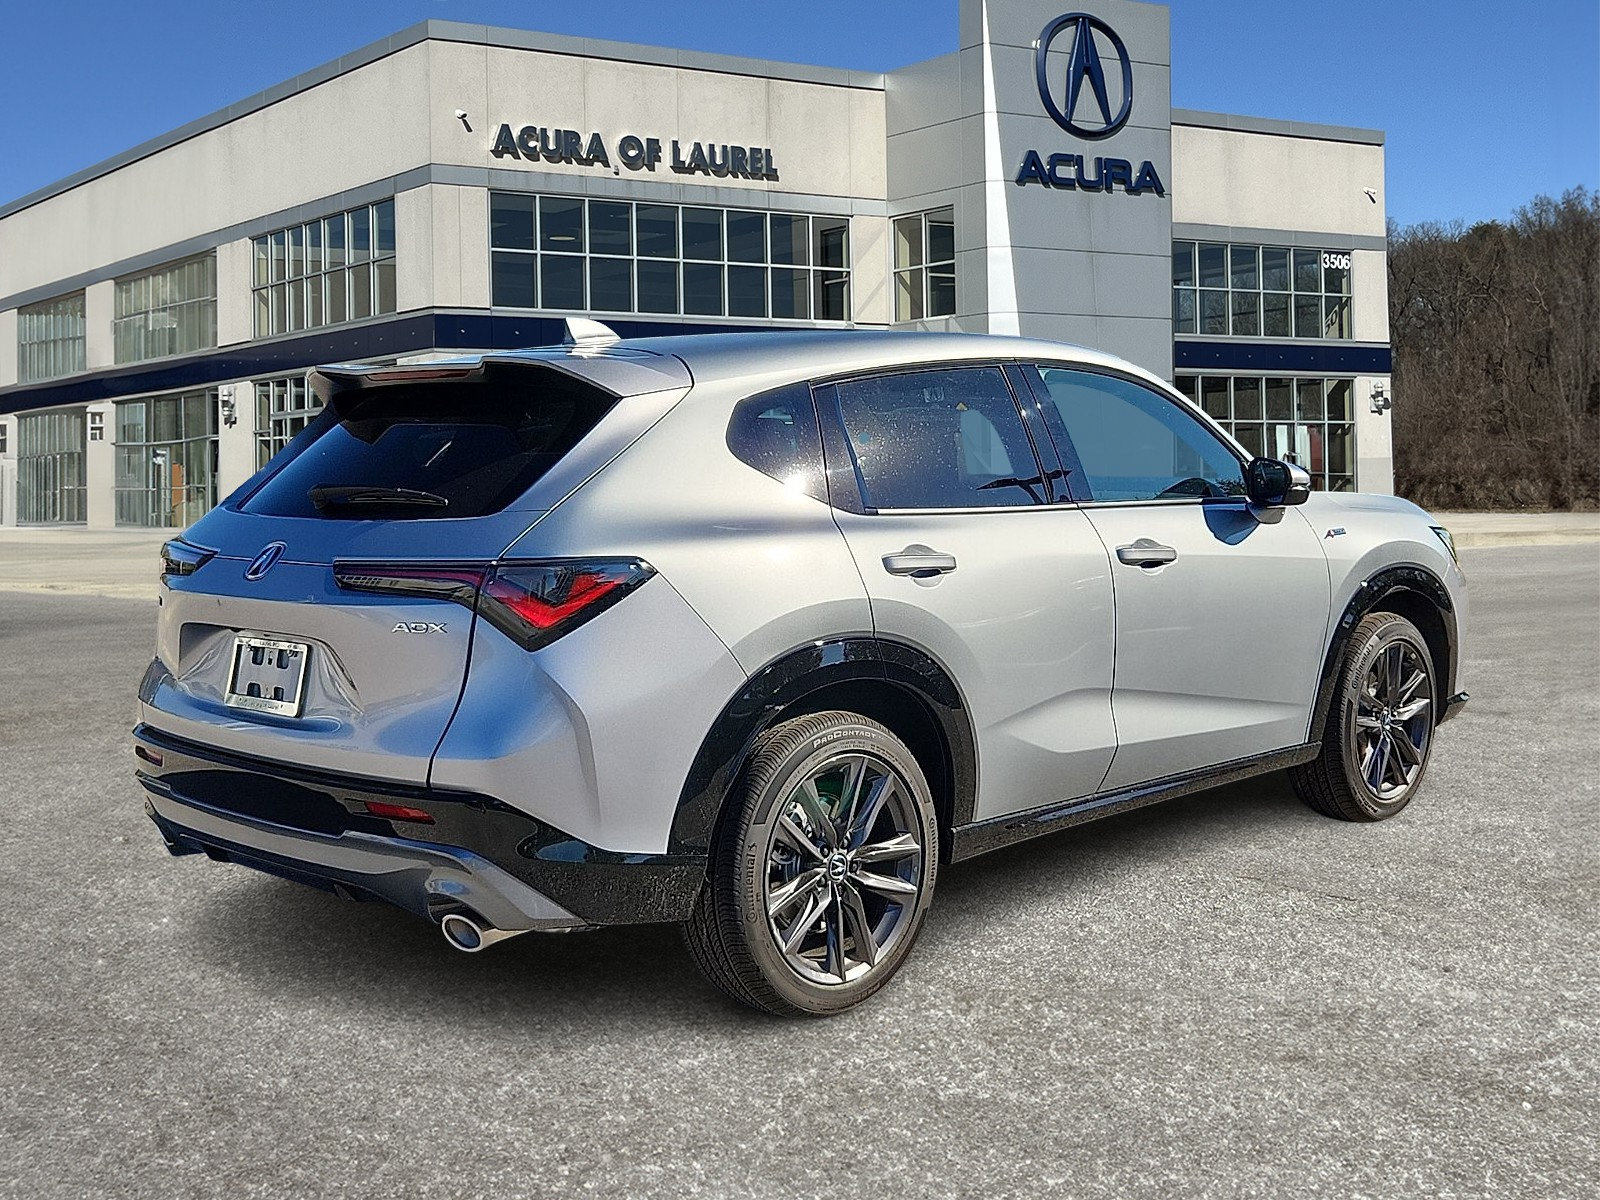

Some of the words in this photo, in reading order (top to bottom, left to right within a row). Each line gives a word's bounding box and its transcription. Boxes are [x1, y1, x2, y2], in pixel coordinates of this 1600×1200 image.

[491, 124, 610, 167] ACURA
[618, 135, 662, 171] OF
[671, 140, 779, 181] LAUREL
[1015, 150, 1165, 198] ACURA
[1323, 254, 1351, 270] 3506
[391, 621, 448, 634] ADX
